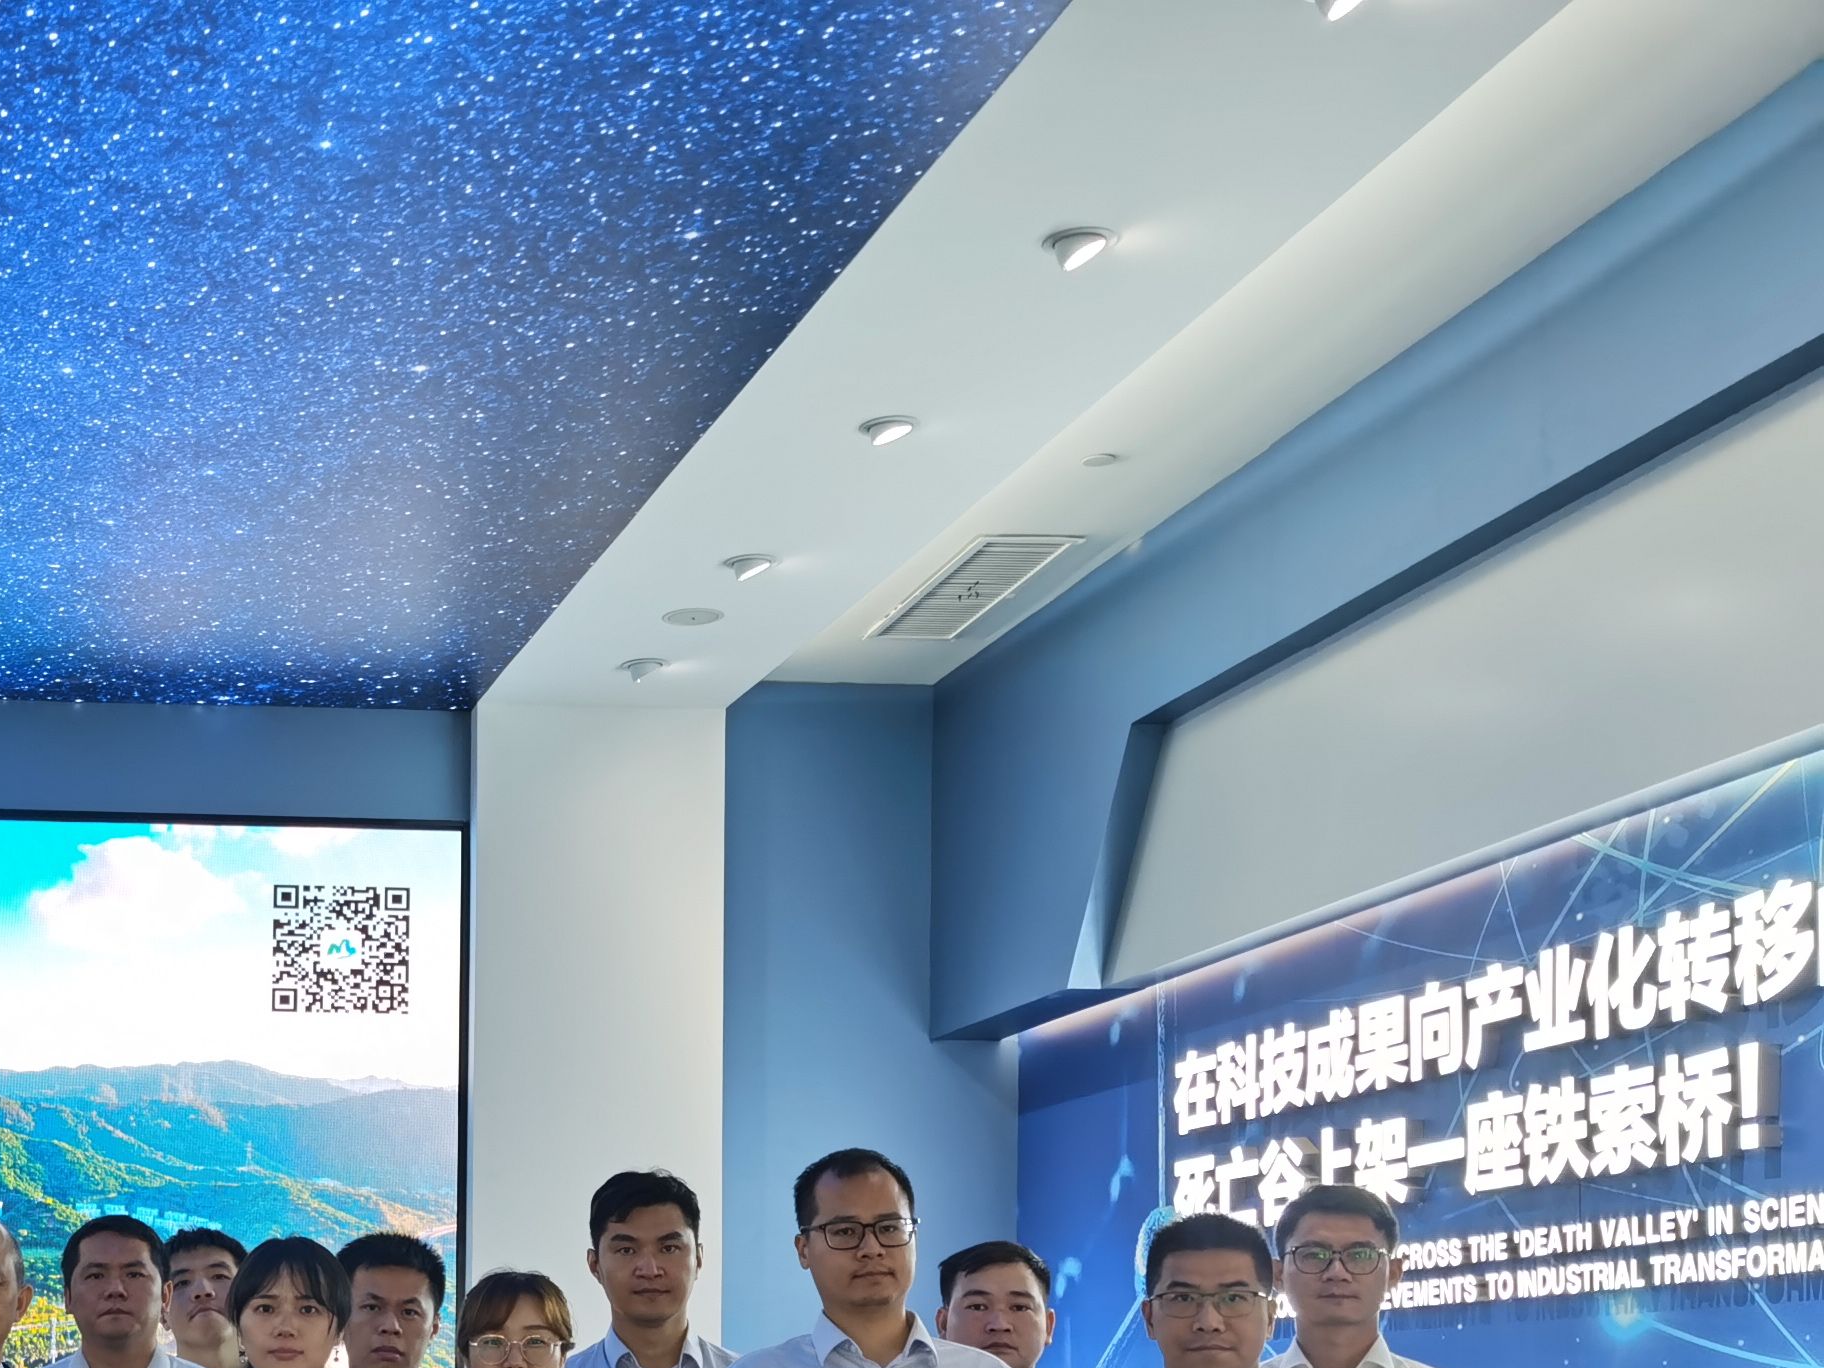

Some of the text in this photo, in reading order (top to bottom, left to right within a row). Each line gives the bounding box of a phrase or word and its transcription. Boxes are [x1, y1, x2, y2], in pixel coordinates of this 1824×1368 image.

[1173, 879, 1824, 1136] 在科技成果向产业化转移
[1391, 1238, 1462, 1272] CROSS
[1467, 1232, 1508, 1264] THE
[1513, 1221, 1592, 1258] 'DEATH
[1599, 1208, 1699, 1249] VALLEY'
[1707, 1204, 1734, 1237] IN
[1485, 1271, 1514, 1301] TO
[1517, 1258, 1646, 1299] INDUSTRIAL
